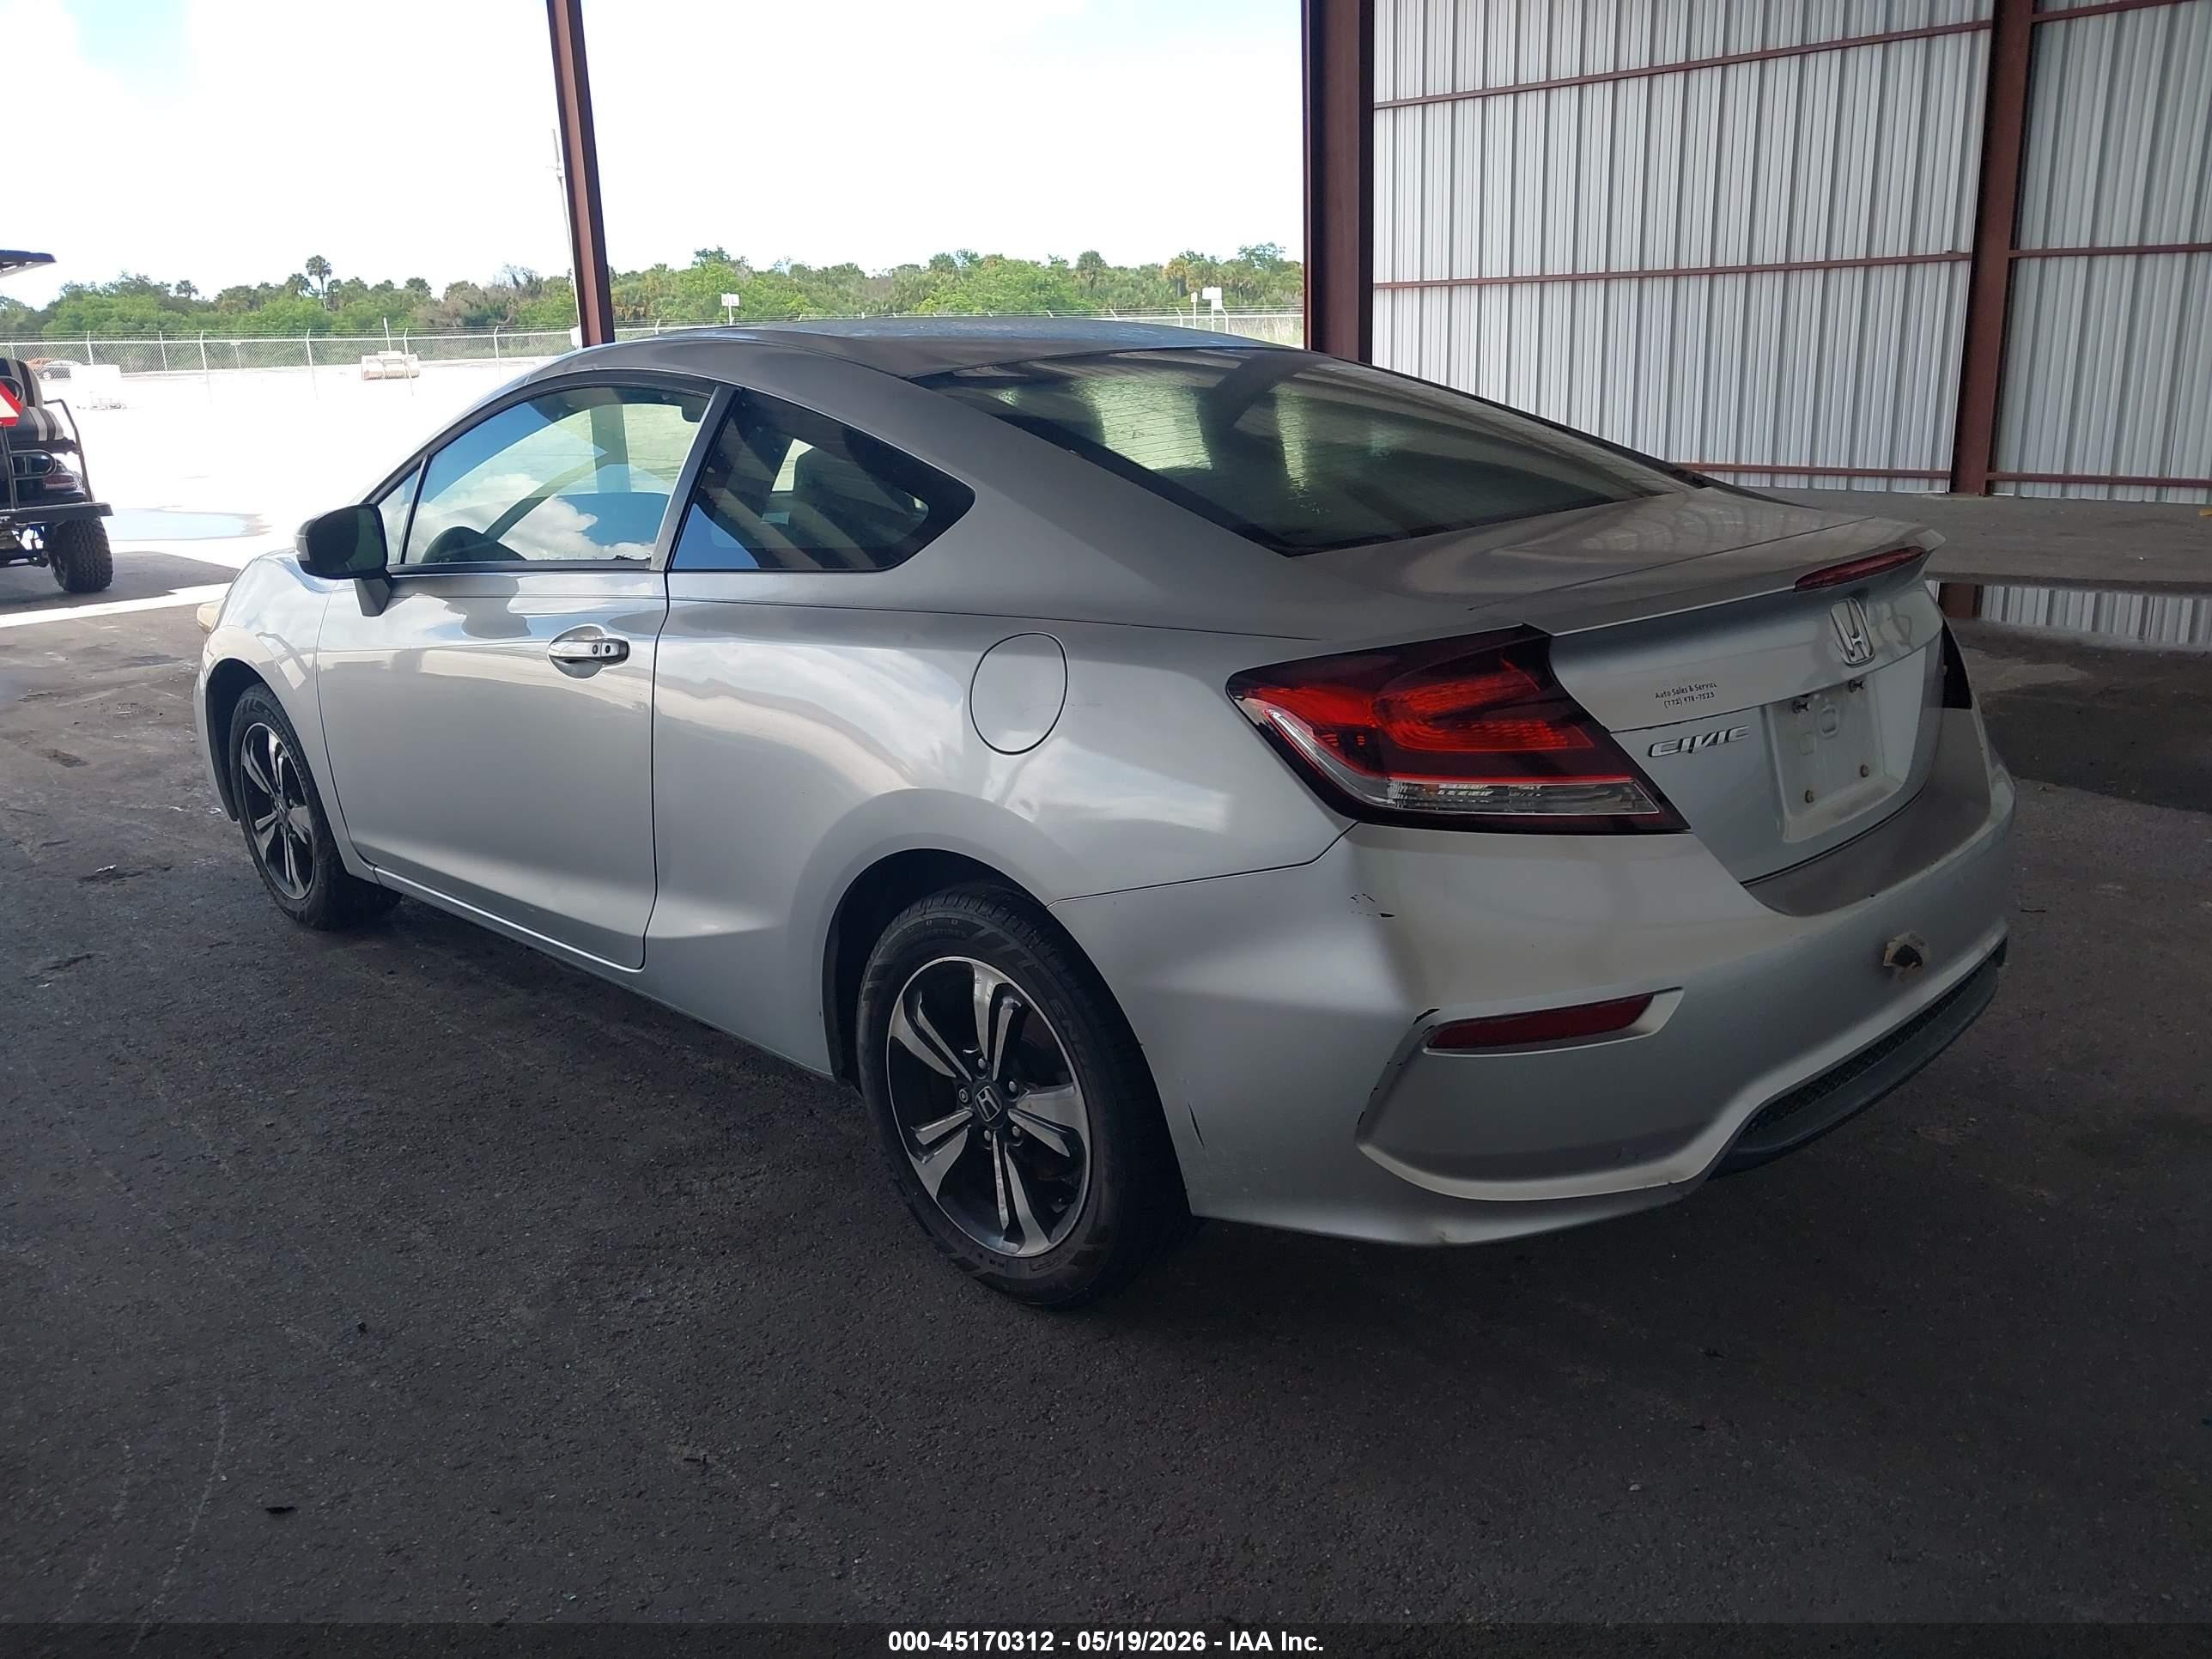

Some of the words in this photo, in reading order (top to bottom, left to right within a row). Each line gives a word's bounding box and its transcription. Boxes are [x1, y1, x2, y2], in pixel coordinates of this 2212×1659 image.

[1655, 690, 1671, 699] Auto
[1672, 686, 1687, 696] Sales
[1694, 683, 1717, 691] Service
[1664, 697, 1683, 708] (772)
[1647, 725, 1749, 757] CIVIC
